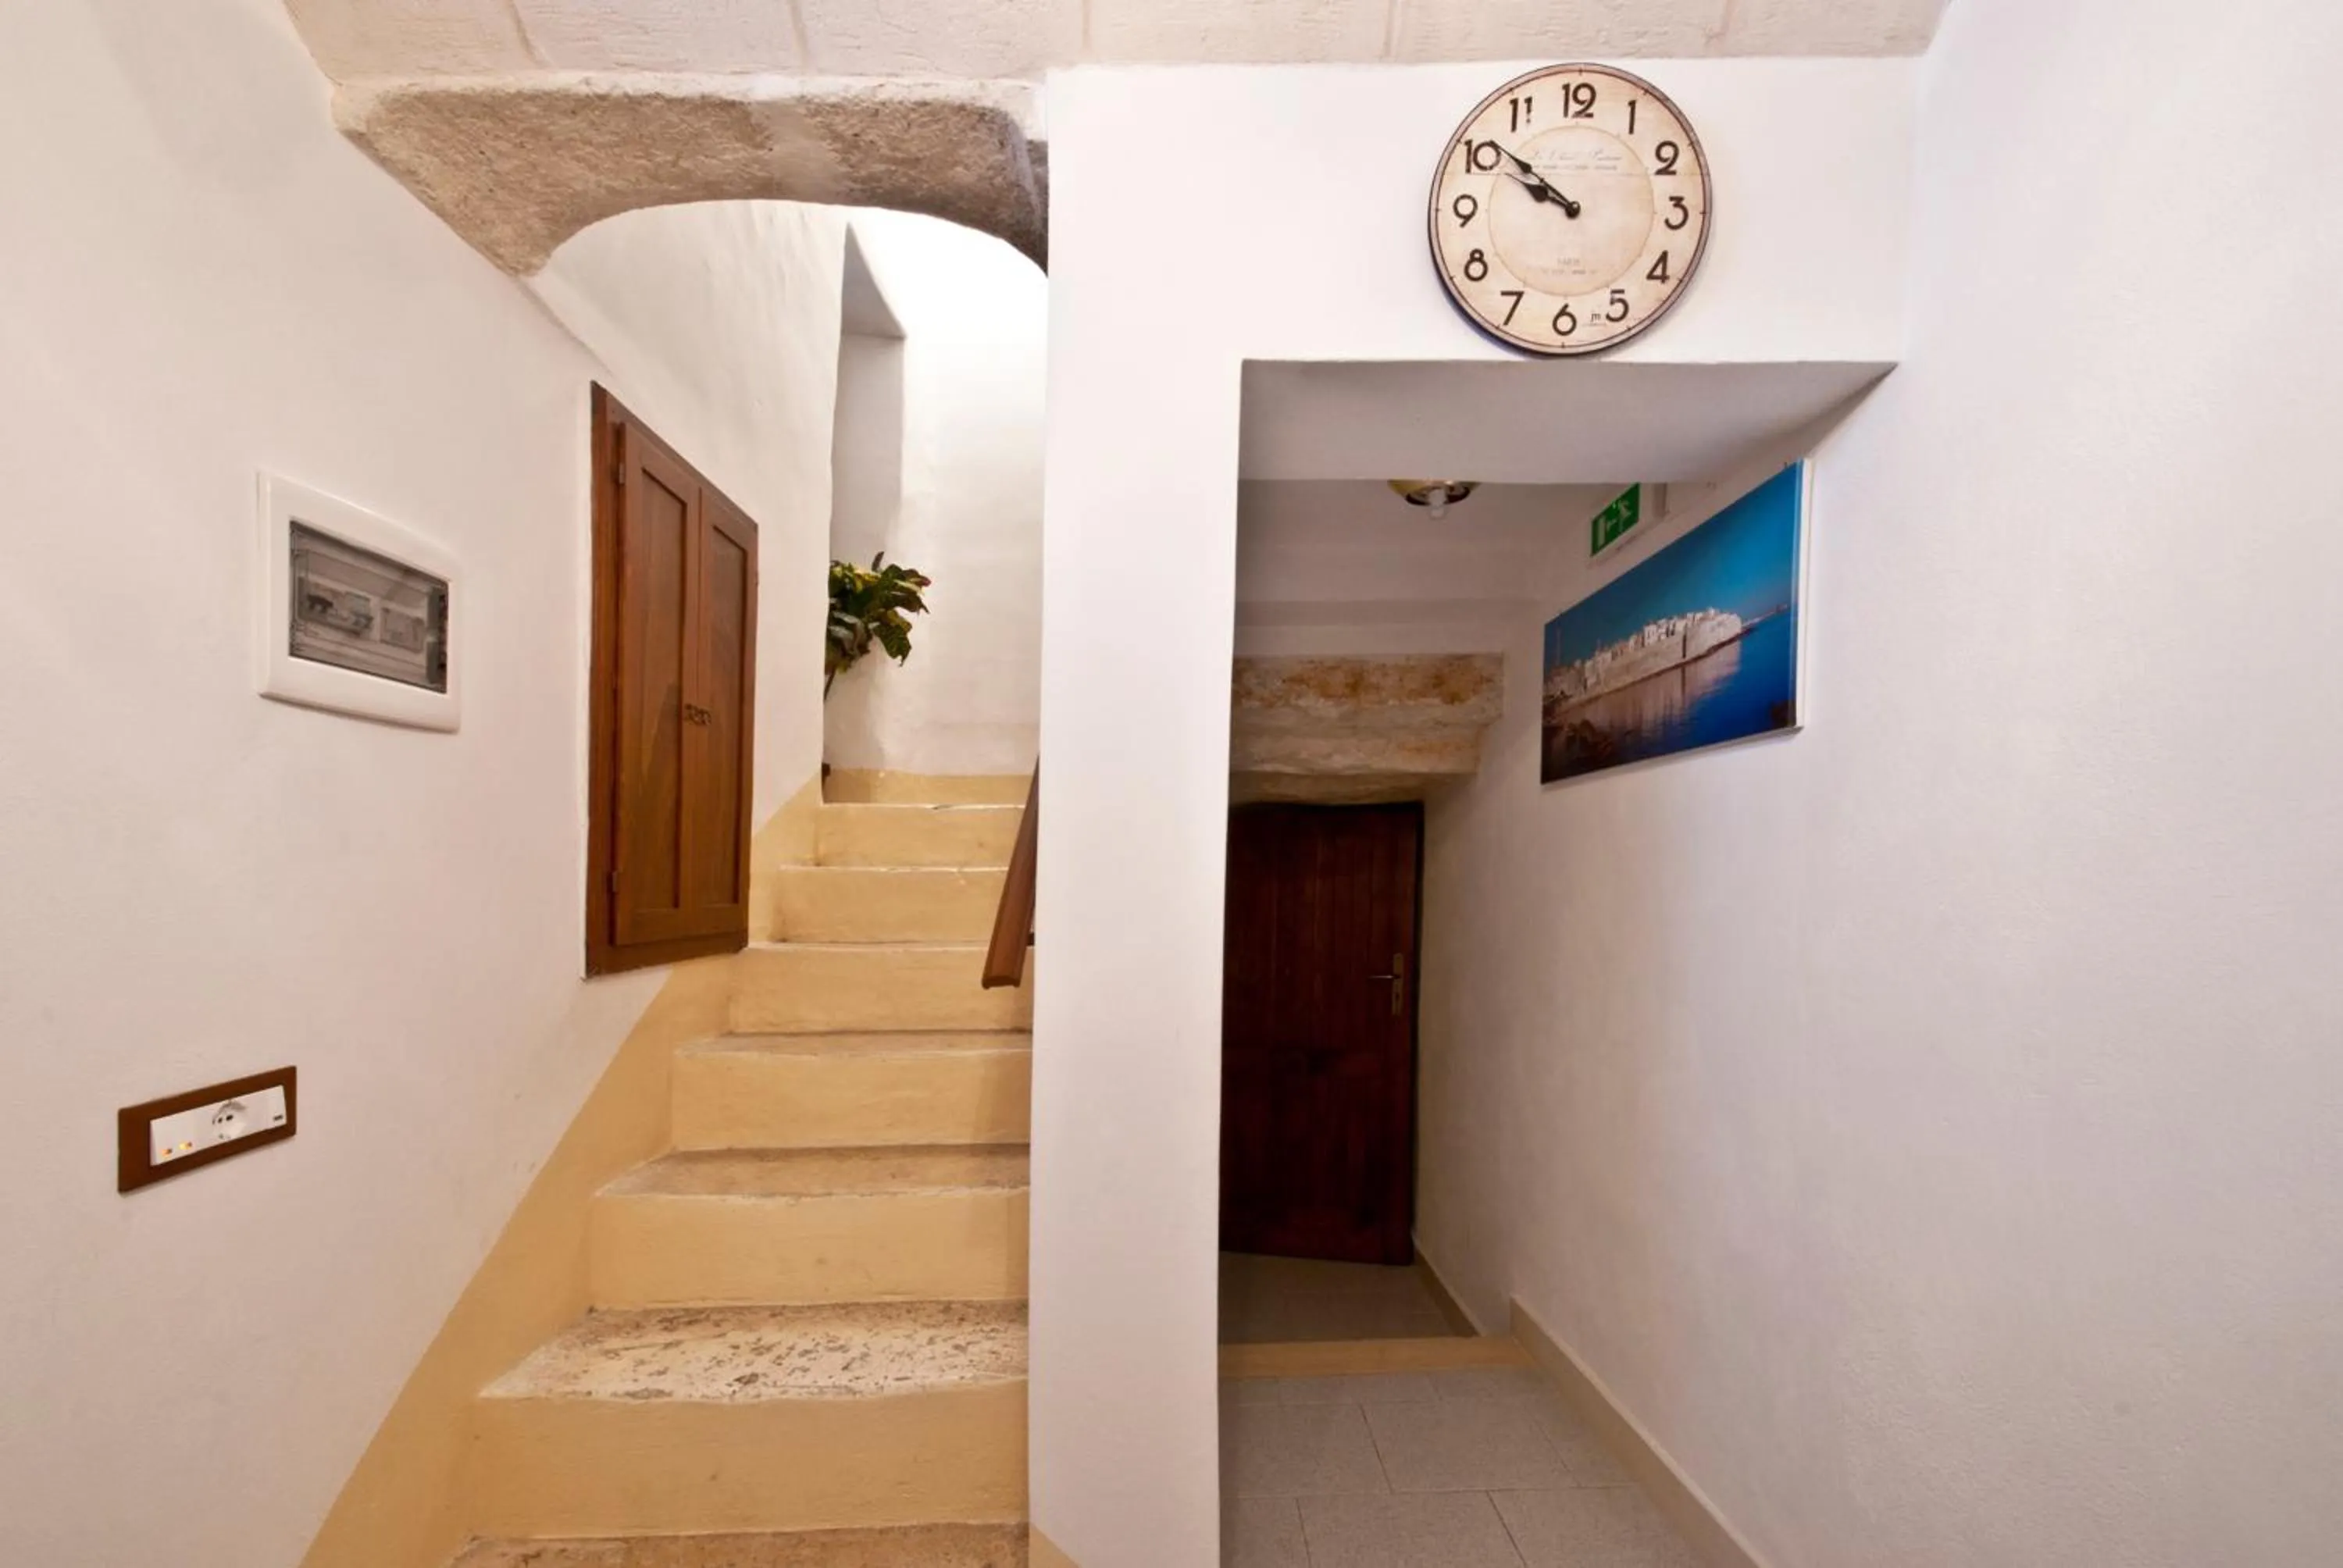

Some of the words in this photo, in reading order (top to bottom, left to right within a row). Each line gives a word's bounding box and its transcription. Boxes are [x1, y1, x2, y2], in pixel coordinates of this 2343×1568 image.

[1562, 83, 1596, 119] 12
[1628, 99, 1637, 135] 1
[1464, 139, 1501, 175] 10
[1654, 141, 1679, 176] 2
[1453, 194, 1478, 228] 9
[1664, 196, 1689, 230] 3
[1464, 248, 1489, 282] 8
[1646, 250, 1671, 284] 4
[1500, 290, 1525, 326] 7
[1552, 303, 1577, 337] 6
[1606, 289, 1629, 323] 5
